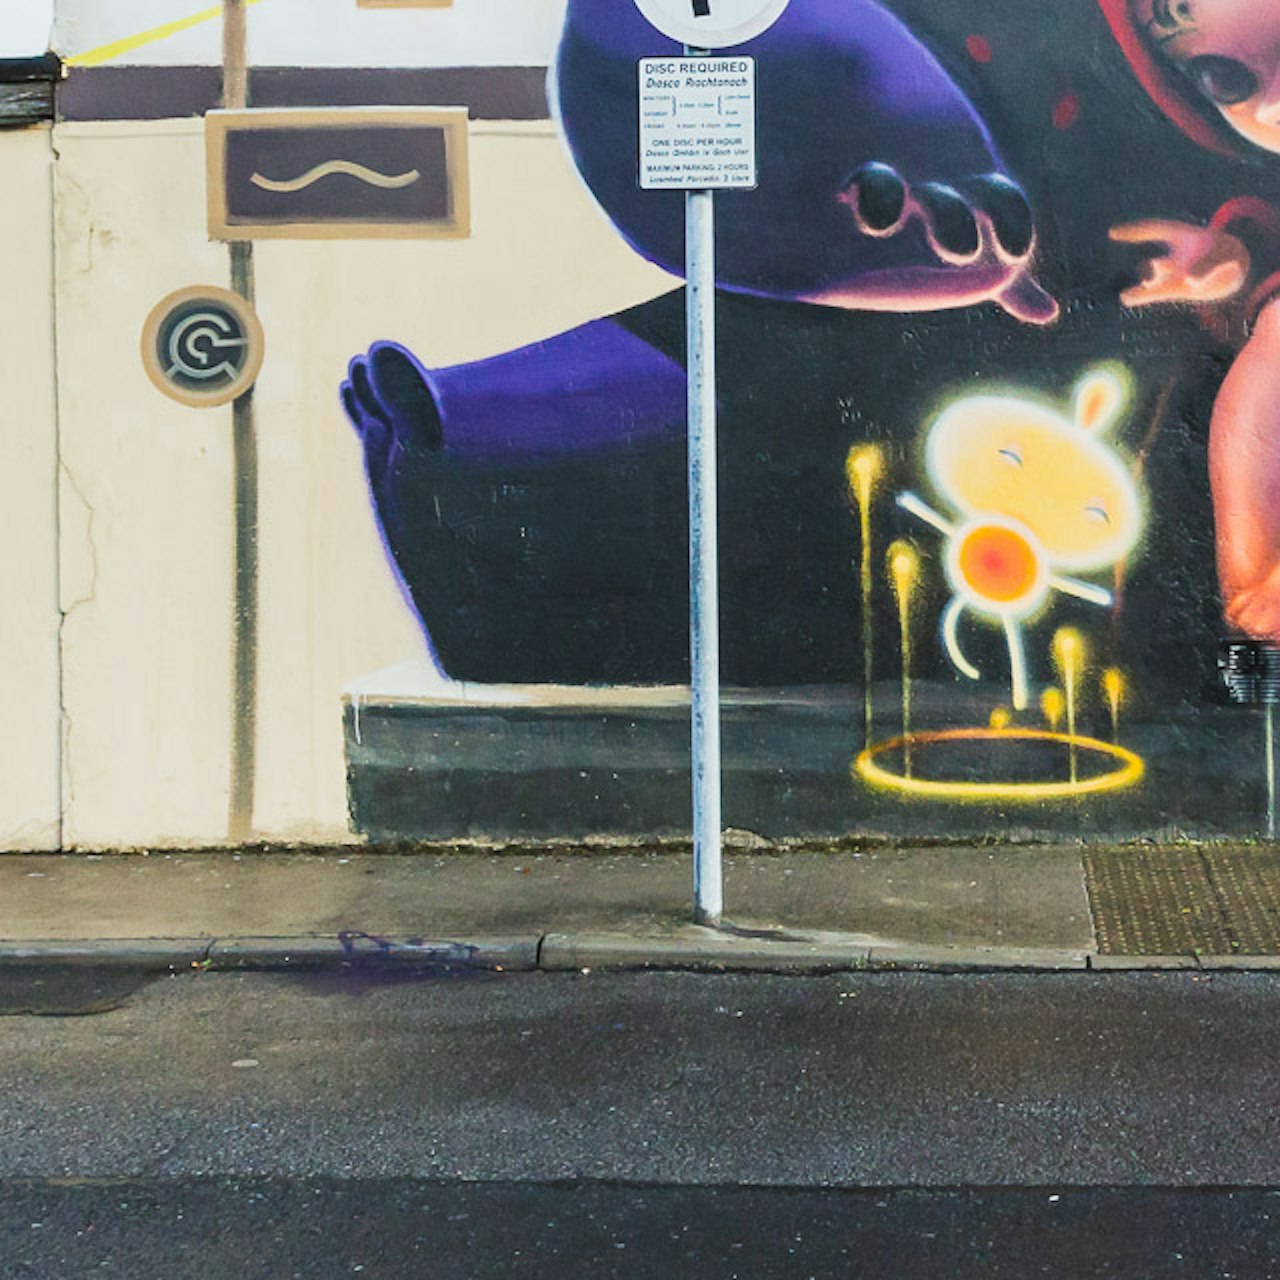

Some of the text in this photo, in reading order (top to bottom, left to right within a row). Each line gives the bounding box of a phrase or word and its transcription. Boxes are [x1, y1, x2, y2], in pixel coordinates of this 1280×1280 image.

[645, 61, 748, 74] DISC REQUIRED
[651, 137, 743, 147] ONE DISC PER HOUR
[682, 163, 715, 172] PARKING
[724, 163, 749, 171] HOURS
